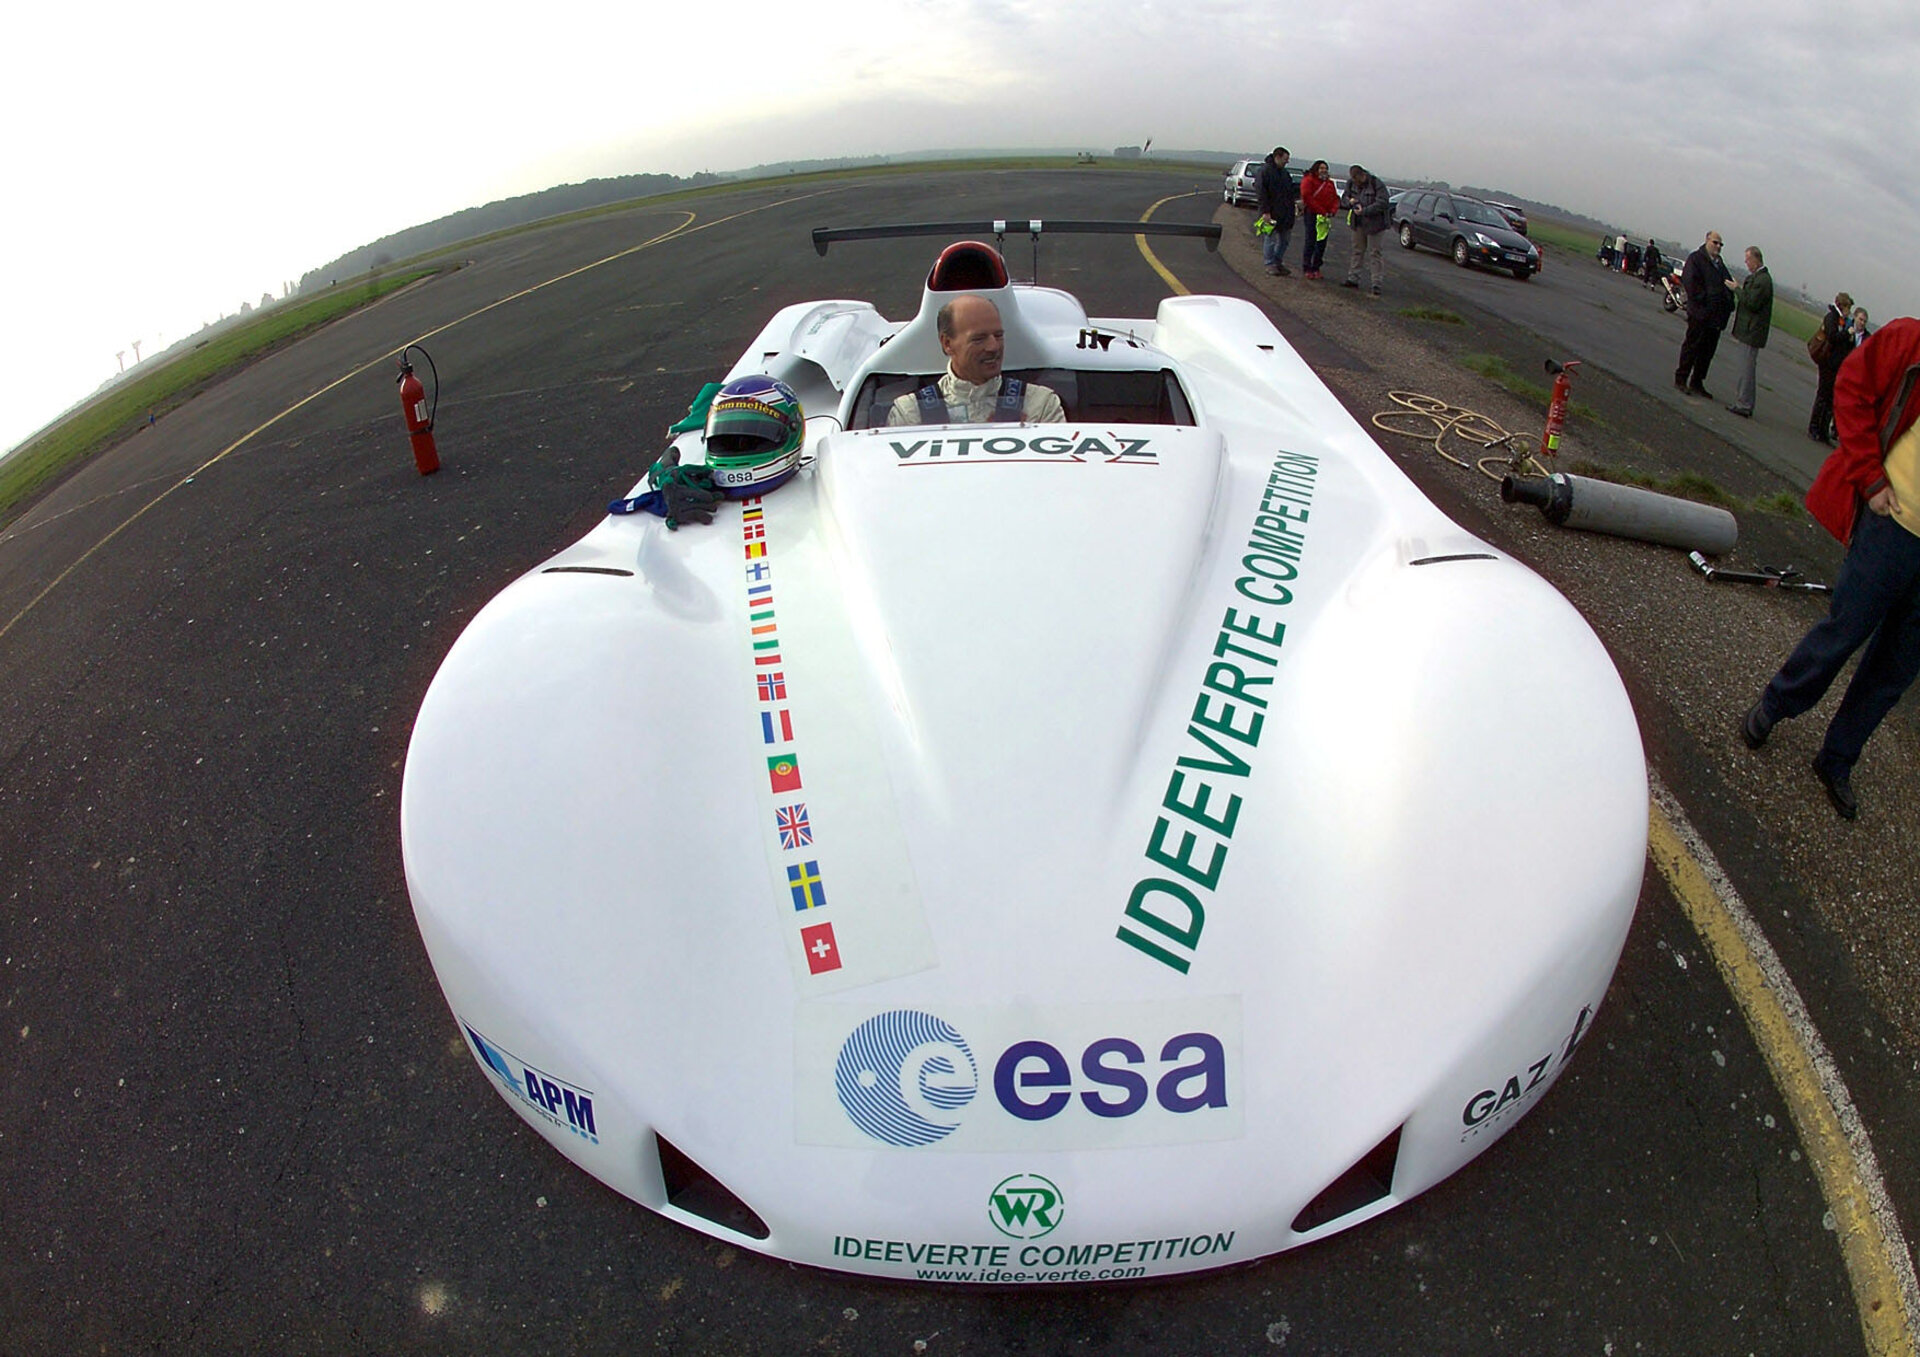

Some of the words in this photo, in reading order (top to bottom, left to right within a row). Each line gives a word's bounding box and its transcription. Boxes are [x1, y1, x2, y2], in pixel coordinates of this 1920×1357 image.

[727, 472, 753, 483] esa
[1116, 605, 1288, 976] IDEEVERTE
[1234, 449, 1320, 606] COMPETITION
[523, 1068, 597, 1136] APM
[993, 1032, 1228, 1121] esa
[833, 1236, 1011, 1267] IDEEVERTE
[1018, 1231, 1236, 1267] COMPETITION
[916, 1265, 1147, 1283] www.idee-verte.com
